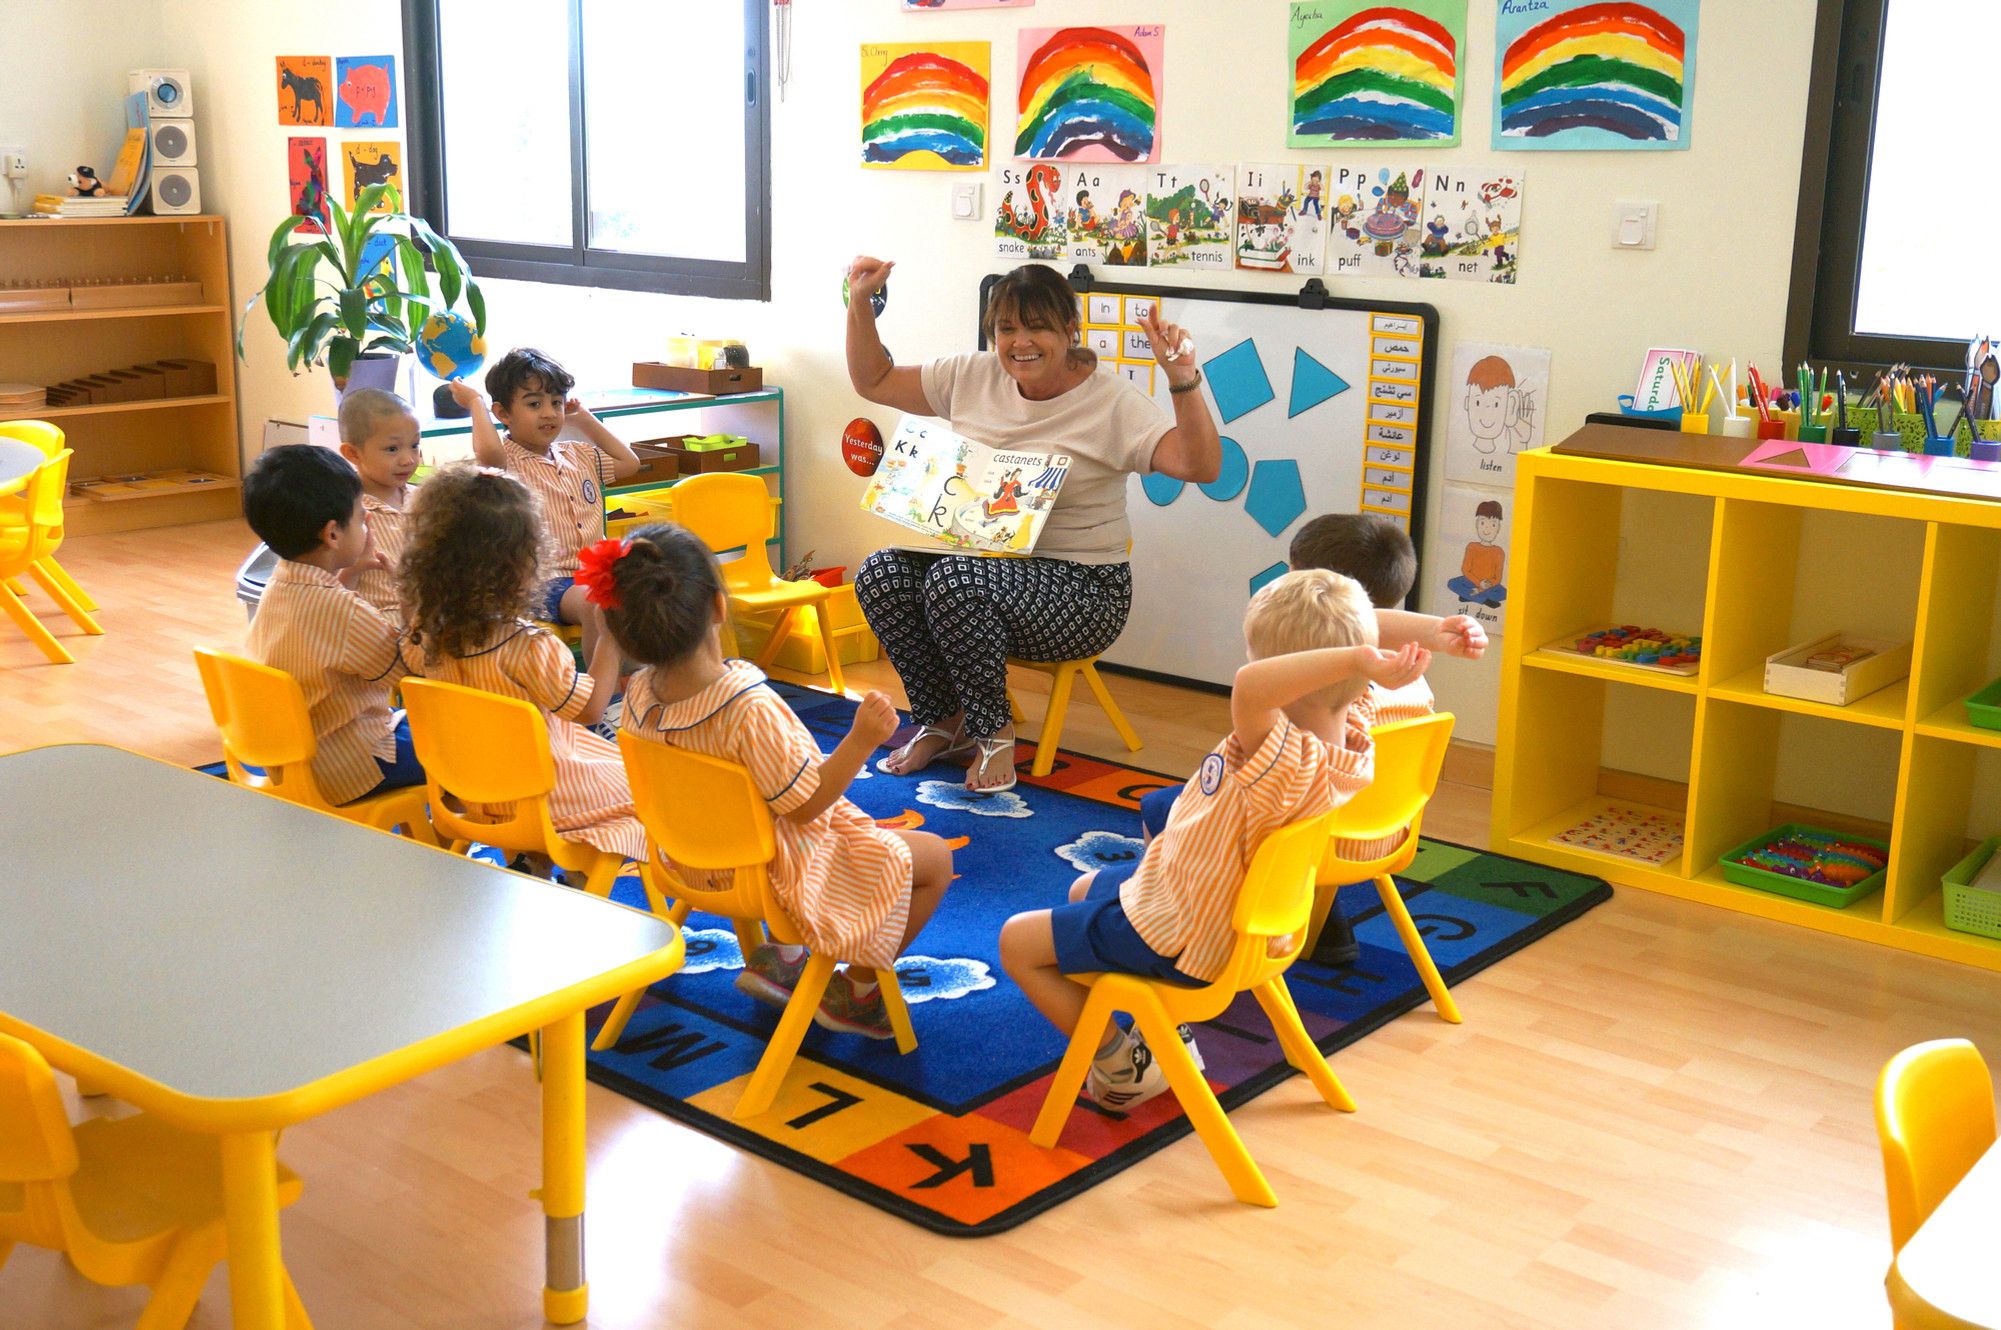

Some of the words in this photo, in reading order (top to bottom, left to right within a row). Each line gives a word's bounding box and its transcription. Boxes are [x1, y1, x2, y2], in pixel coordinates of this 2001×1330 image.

[1501, 0, 1549, 15] Arantza
[1003, 169, 1011, 184] S
[1015, 174, 1021, 185] s
[1077, 172, 1088, 187] A
[1092, 177, 1100, 187] a
[1157, 173, 1166, 188] T
[1170, 176, 1178, 189] t
[1340, 168, 1350, 184] P
[1357, 173, 1366, 190] p
[1435, 175, 1449, 192] N
[1456, 181, 1465, 192] n
[998, 241, 1025, 254] snake
[1075, 246, 1096, 258] ants
[1191, 249, 1224, 263] tennis
[1297, 253, 1315, 267] ink
[1338, 253, 1362, 271] puff
[1458, 260, 1478, 273] net
[1135, 303, 1148, 317] to
[1100, 340, 1106, 349] a
[1130, 335, 1151, 349] the
[1647, 356, 1670, 411] Saturda
[845, 433, 883, 456] Yesterday
[894, 440, 908, 454] K
[909, 444, 919, 459] k
[993, 454, 1043, 467] castanets
[1480, 458, 1502, 472] listen
[927, 493, 947, 528] k
[1458, 605, 1468, 615] sit
[1475, 608, 1498, 622] down
[785, 1081, 864, 1130] L
[904, 1143, 995, 1189] K
